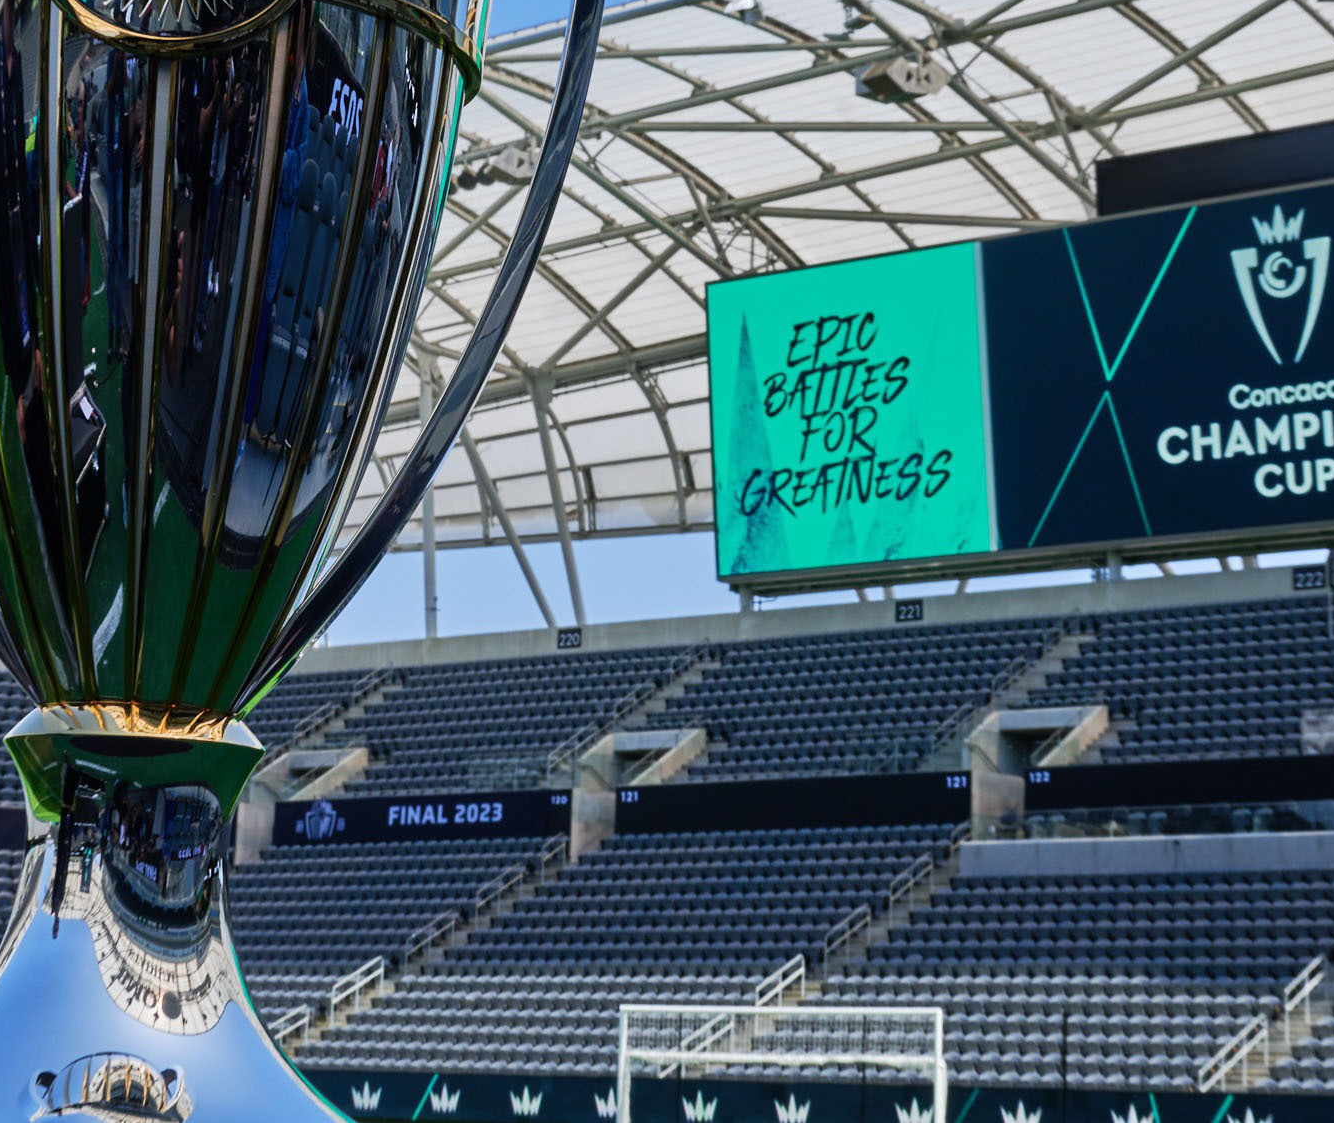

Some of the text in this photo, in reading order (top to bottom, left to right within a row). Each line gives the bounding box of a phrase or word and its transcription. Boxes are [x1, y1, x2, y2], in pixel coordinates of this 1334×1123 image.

[787, 312, 879, 370] EPIC
[763, 356, 910, 419] BATTLES
[799, 405, 879, 463] FOR
[740, 449, 952, 517] GREATNESS
[1295, 570, 1324, 588] 222
[898, 603, 921, 620] 221
[559, 632, 580, 647] 220
[946, 775, 967, 788] 121
[1028, 771, 1051, 784] 122
[620, 791, 639, 804] 121
[387, 803, 503, 826] FINAL 2023
